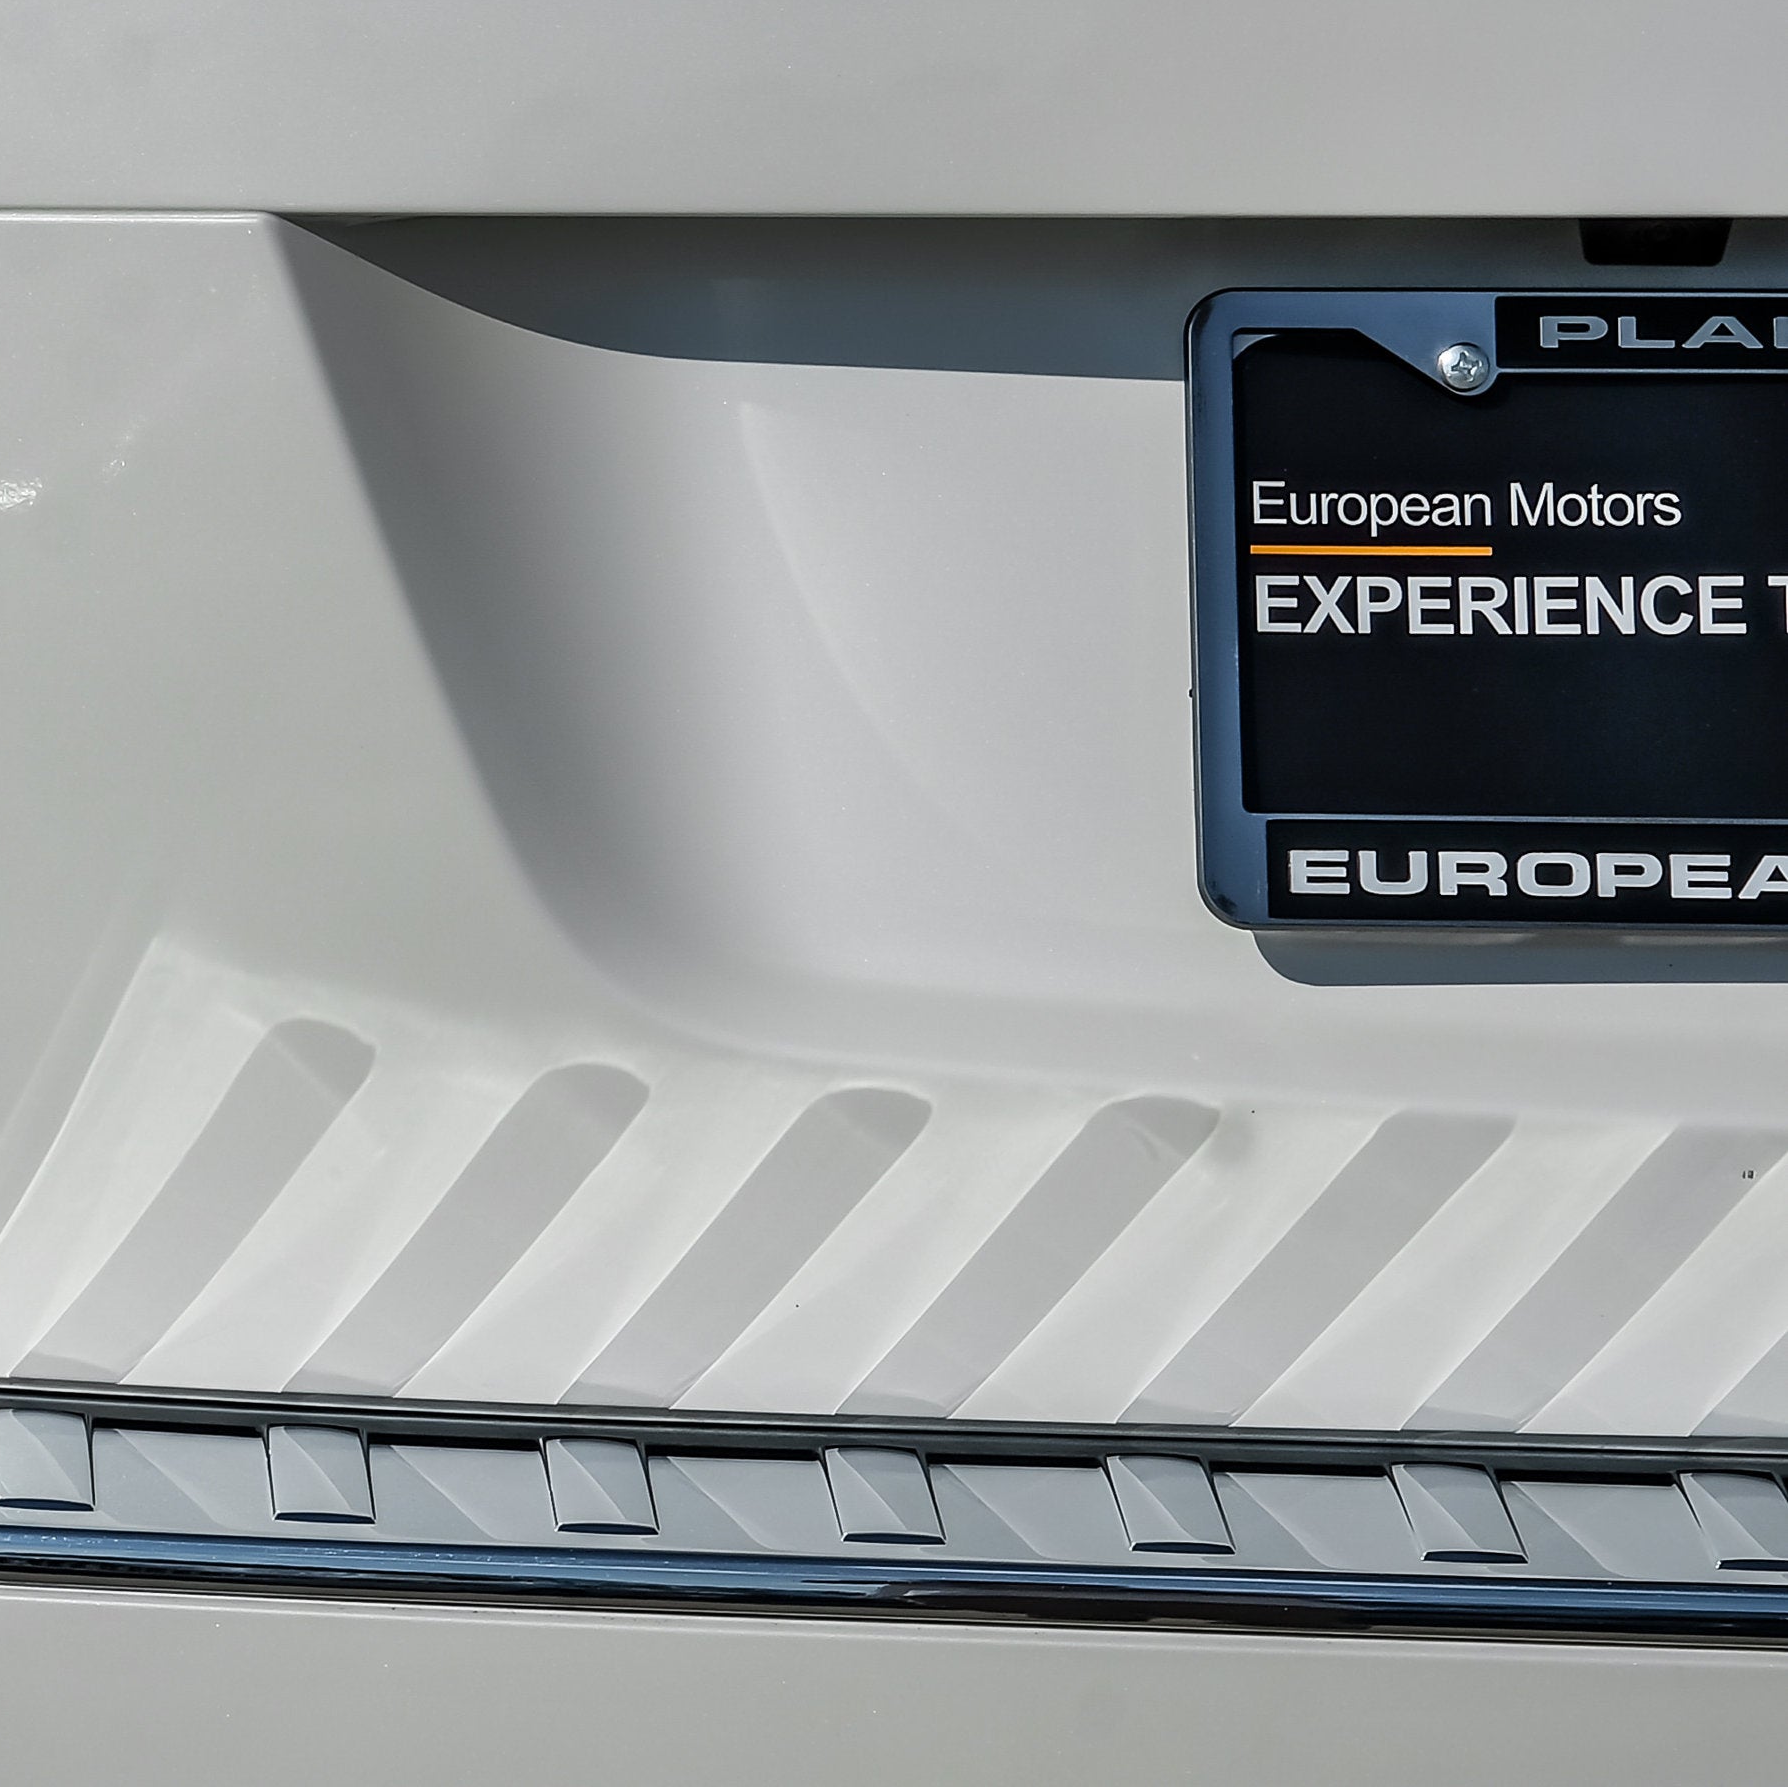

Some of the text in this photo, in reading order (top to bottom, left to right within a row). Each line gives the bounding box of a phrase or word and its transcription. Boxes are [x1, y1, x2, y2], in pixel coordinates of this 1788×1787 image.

[1539, 315, 1788, 349] PLA
[1251, 480, 1682, 538] European Motors
[1255, 575, 1747, 636] EXPERIENCE
